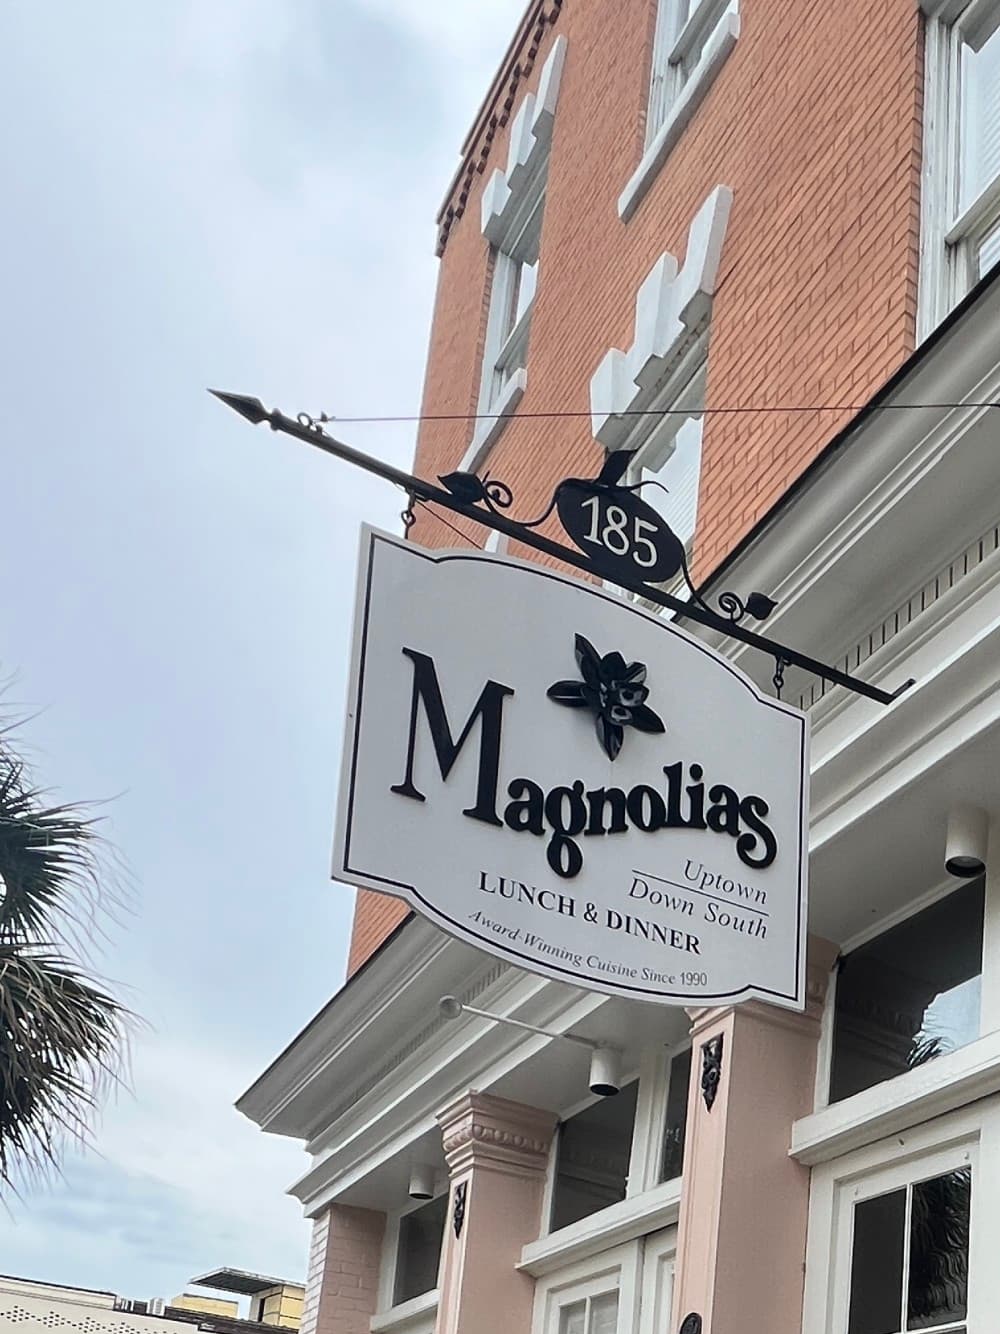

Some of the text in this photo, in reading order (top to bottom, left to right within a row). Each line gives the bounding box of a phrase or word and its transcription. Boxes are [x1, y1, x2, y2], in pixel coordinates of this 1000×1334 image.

[581, 496, 658, 568] 185
[390, 646, 777, 879] Magnolias
[478, 871, 701, 955] LUNCH & DINNER
[628, 877, 767, 939] Down South
[684, 859, 767, 905] Uptown
[468, 910, 708, 987] Award-Winning Cuisine Since 1990
